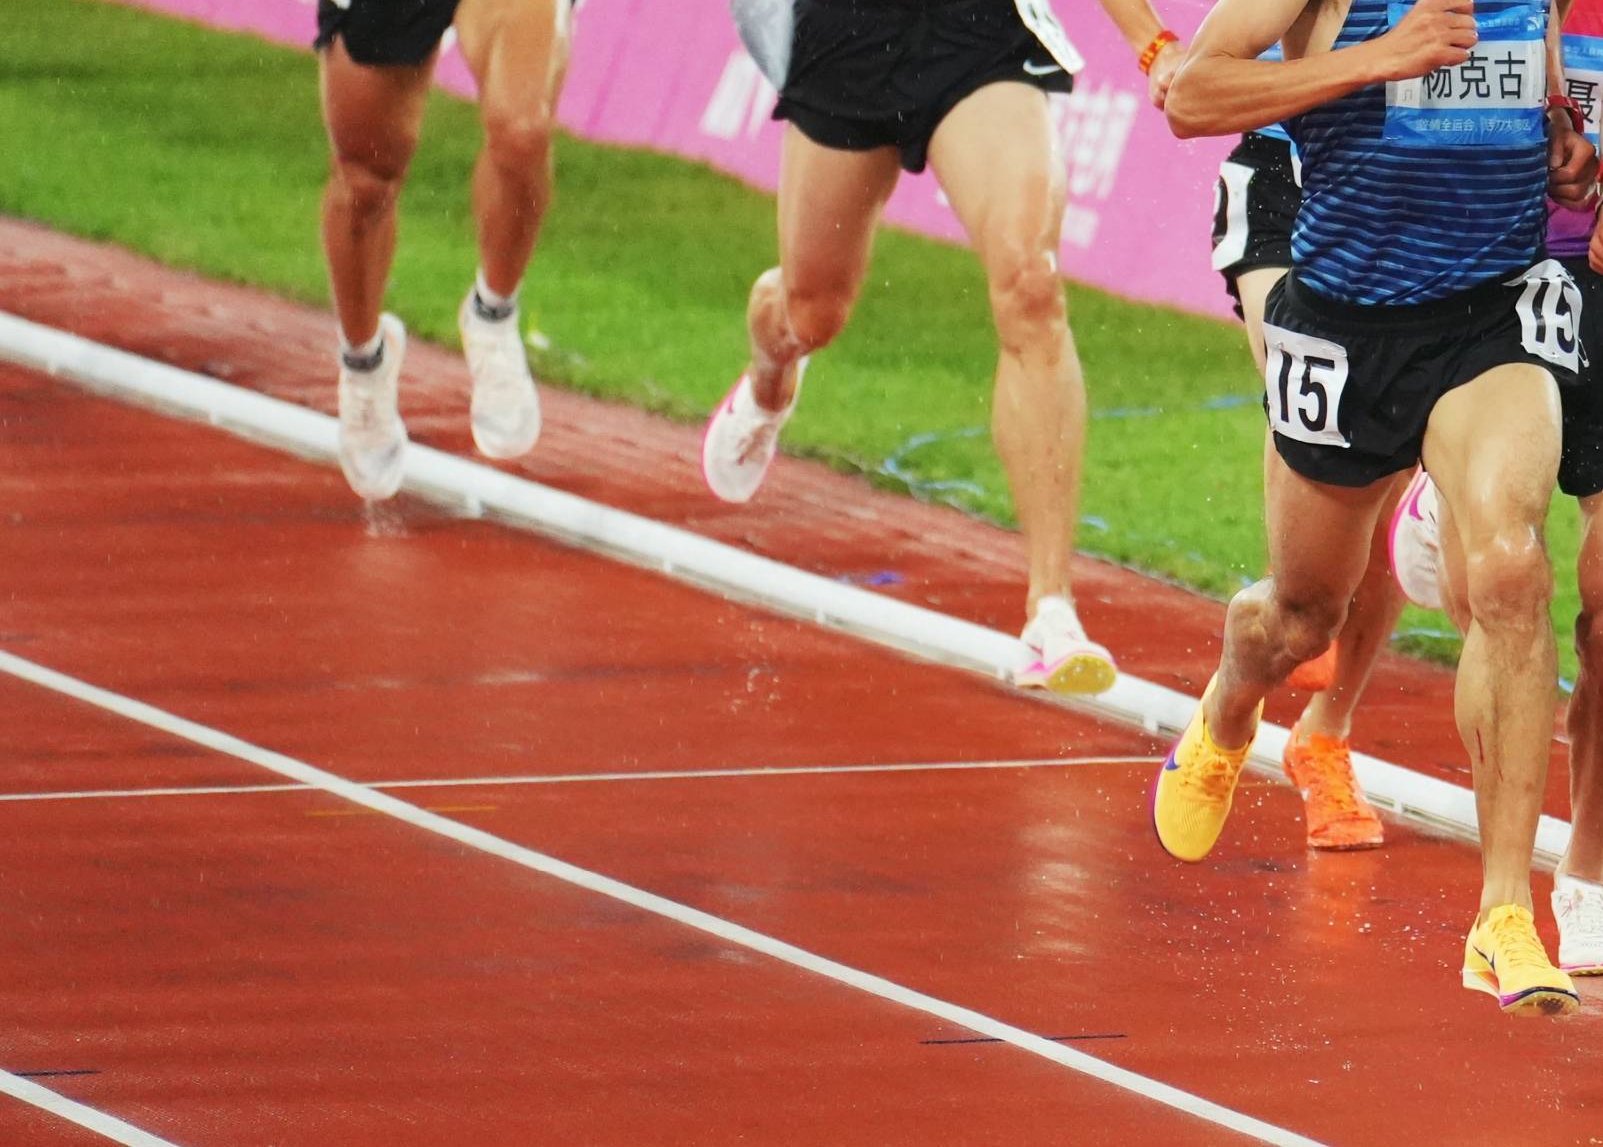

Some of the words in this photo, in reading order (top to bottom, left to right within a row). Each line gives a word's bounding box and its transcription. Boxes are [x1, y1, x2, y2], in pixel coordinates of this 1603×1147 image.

[1423, 51, 1526, 100] 杨克古
[1534, 277, 1577, 354] 15
[1277, 350, 1336, 433] 15
